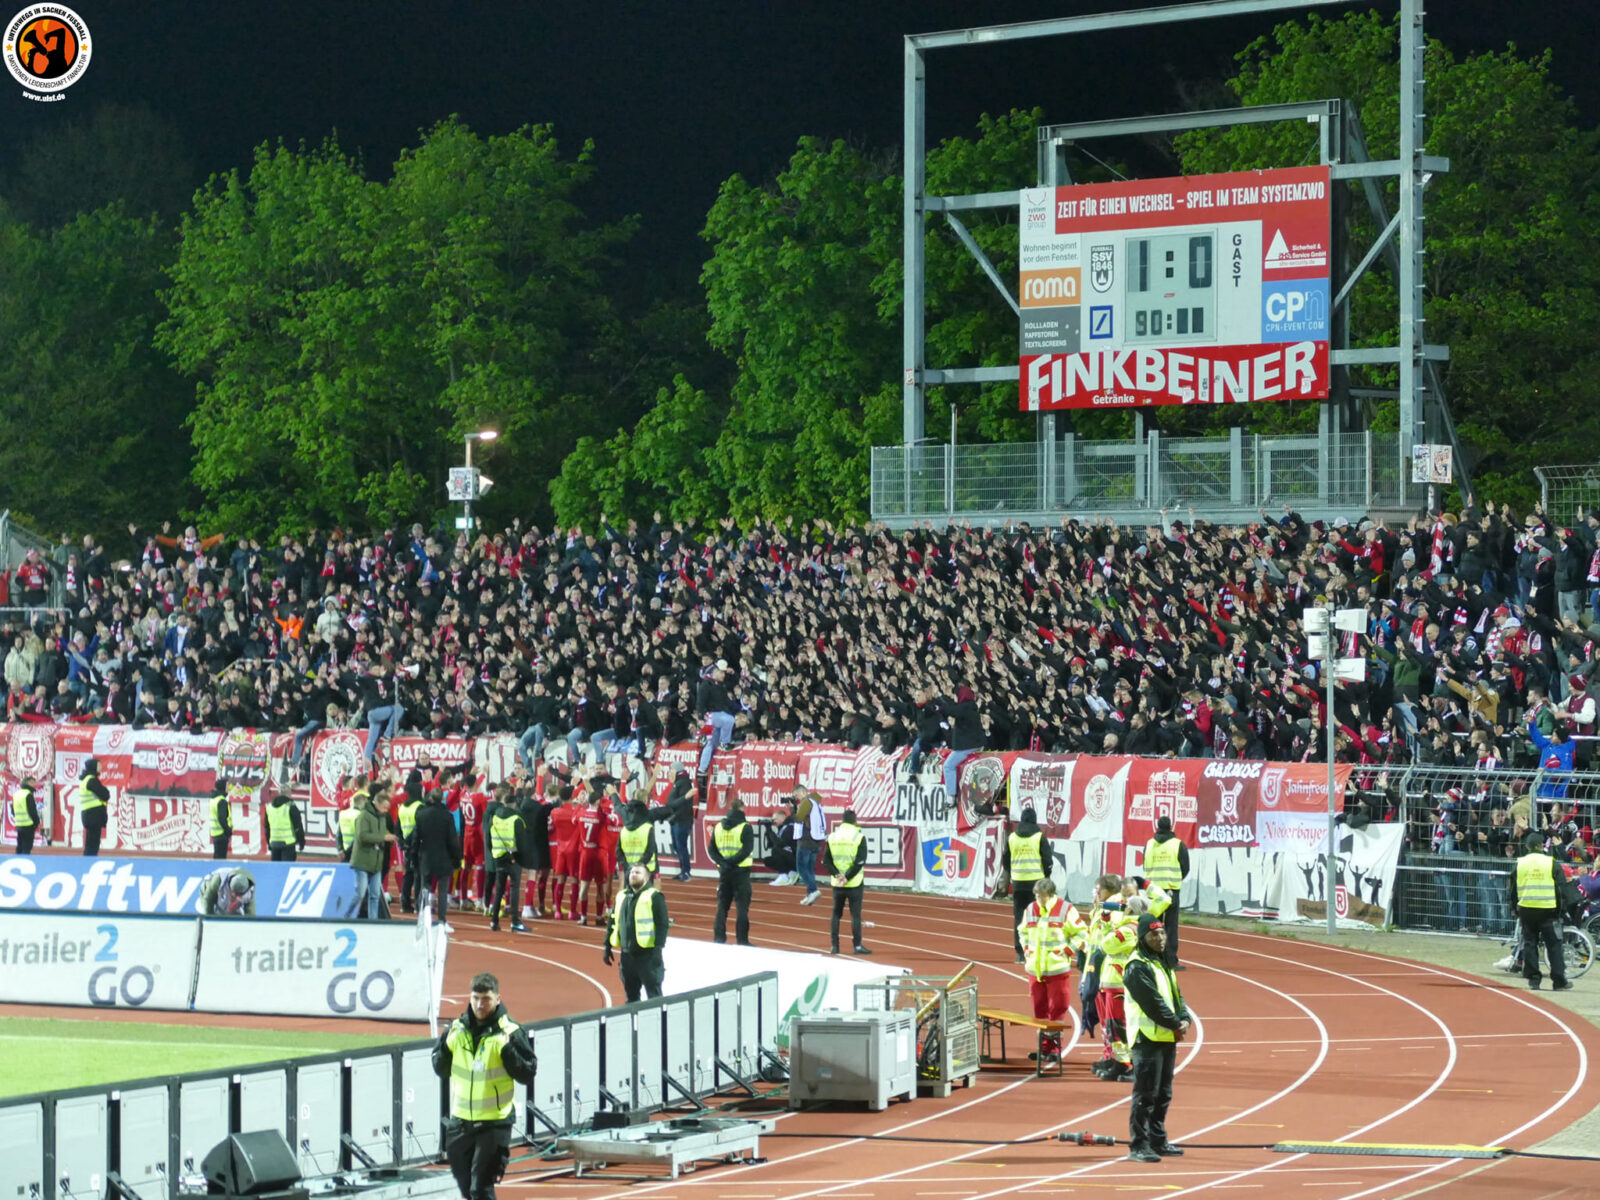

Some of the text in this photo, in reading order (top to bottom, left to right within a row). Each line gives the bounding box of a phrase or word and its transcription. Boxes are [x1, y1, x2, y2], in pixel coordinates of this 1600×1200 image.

[1058, 201, 1078, 218] ZEIT
[1080, 197, 1097, 217] FÜR
[1100, 197, 1126, 215] EINEN
[1129, 193, 1175, 213] WECHSEL
[1186, 190, 1214, 209] SPIEL
[1216, 189, 1229, 206] IM
[1232, 186, 1258, 205] TEAM
[1261, 181, 1325, 203] SYSTEMZWO
[1022, 241, 1077, 253] Wohnen beginnt
[1091, 251, 1113, 262] SSV
[1022, 256, 1034, 264] vor
[1035, 254, 1050, 263] dem
[1091, 261, 1113, 272] 1846
[1024, 276, 1077, 300] roma
[1024, 339, 1067, 348] TEXTILSCREENS
[1028, 341, 1318, 410] FINKBEINER
[1092, 393, 1135, 405] Getränke
[658, 749, 697, 762] SEKTION
[740, 758, 796, 783] Die Power
[799, 757, 855, 791] JGS
[738, 788, 760, 808] vom
[137, 817, 187, 840] TRADITIONSVEREIN
[583, 822, 594, 841] 7
[1263, 820, 1327, 847] Niederbayer
[0, 924, 119, 965] trailer 2
[231, 928, 358, 974] trailer 2
[88, 965, 155, 1006] GO
[326, 970, 395, 1014] GO
